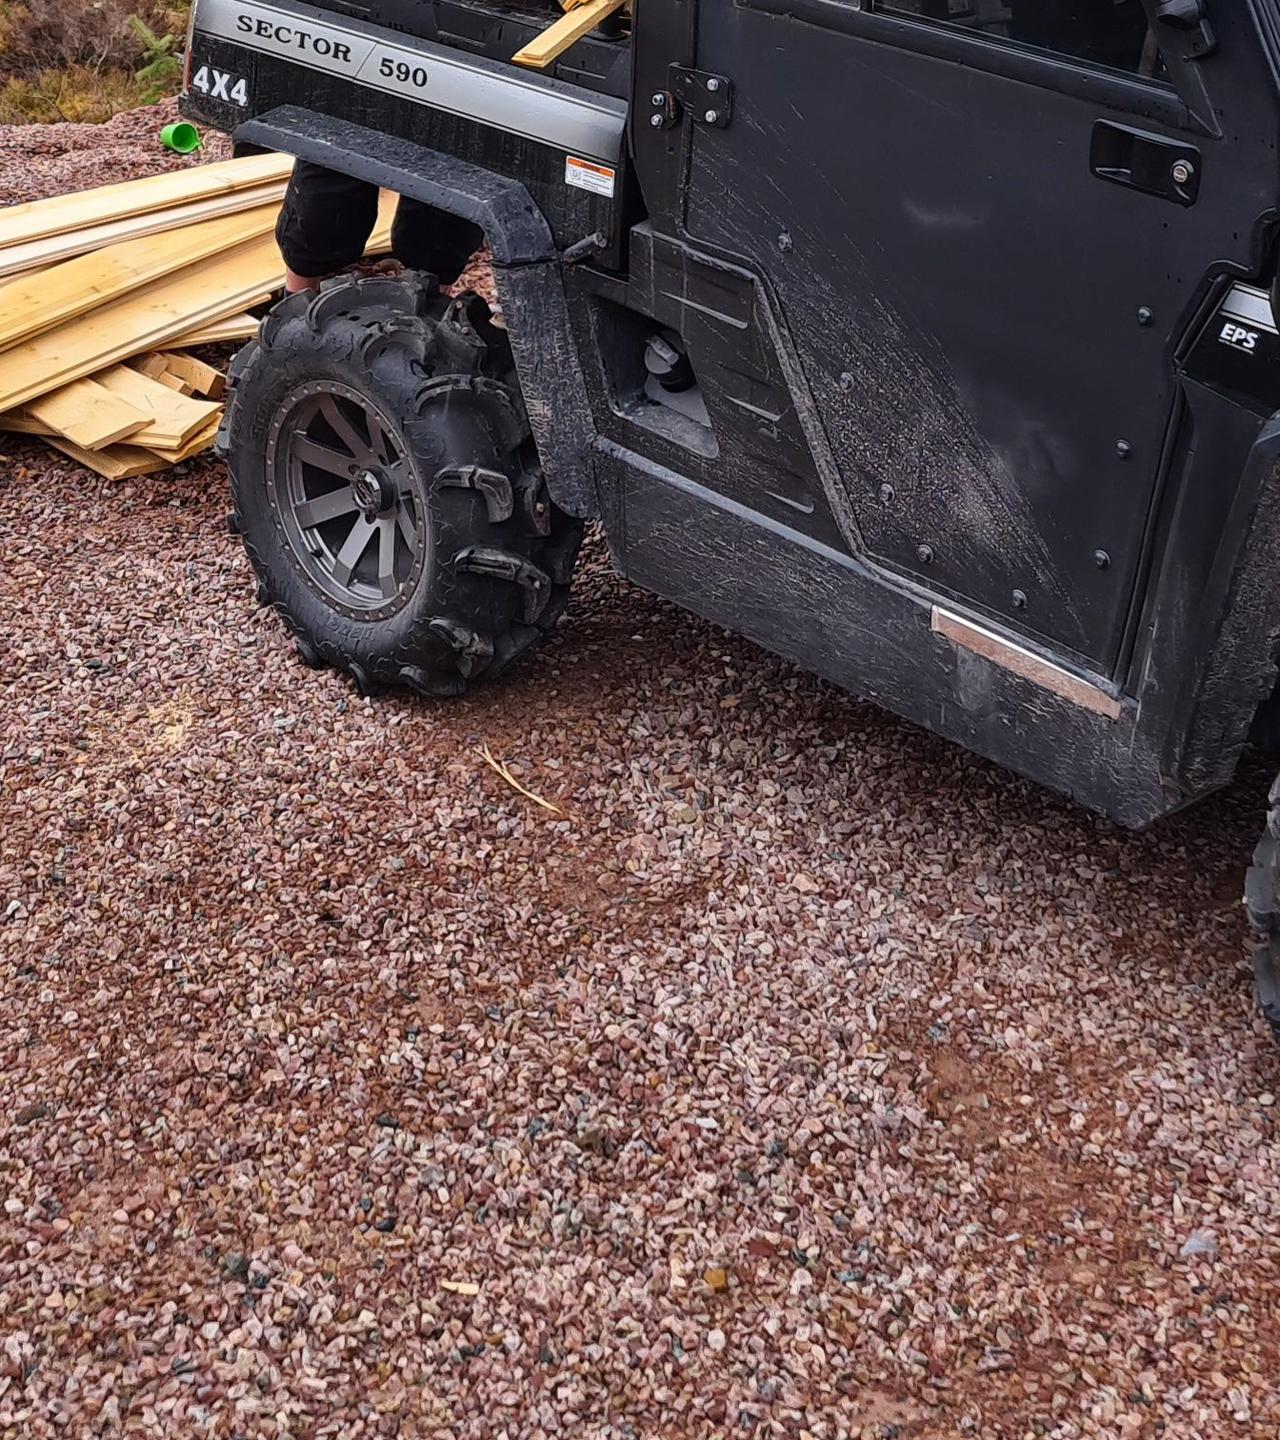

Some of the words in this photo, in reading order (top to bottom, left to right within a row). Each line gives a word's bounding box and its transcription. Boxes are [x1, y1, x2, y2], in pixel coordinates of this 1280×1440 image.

[236, 14, 352, 63] SECTOR
[379, 56, 428, 88] 590
[192, 65, 248, 107] 4X4
[1220, 322, 1259, 348] EPS
